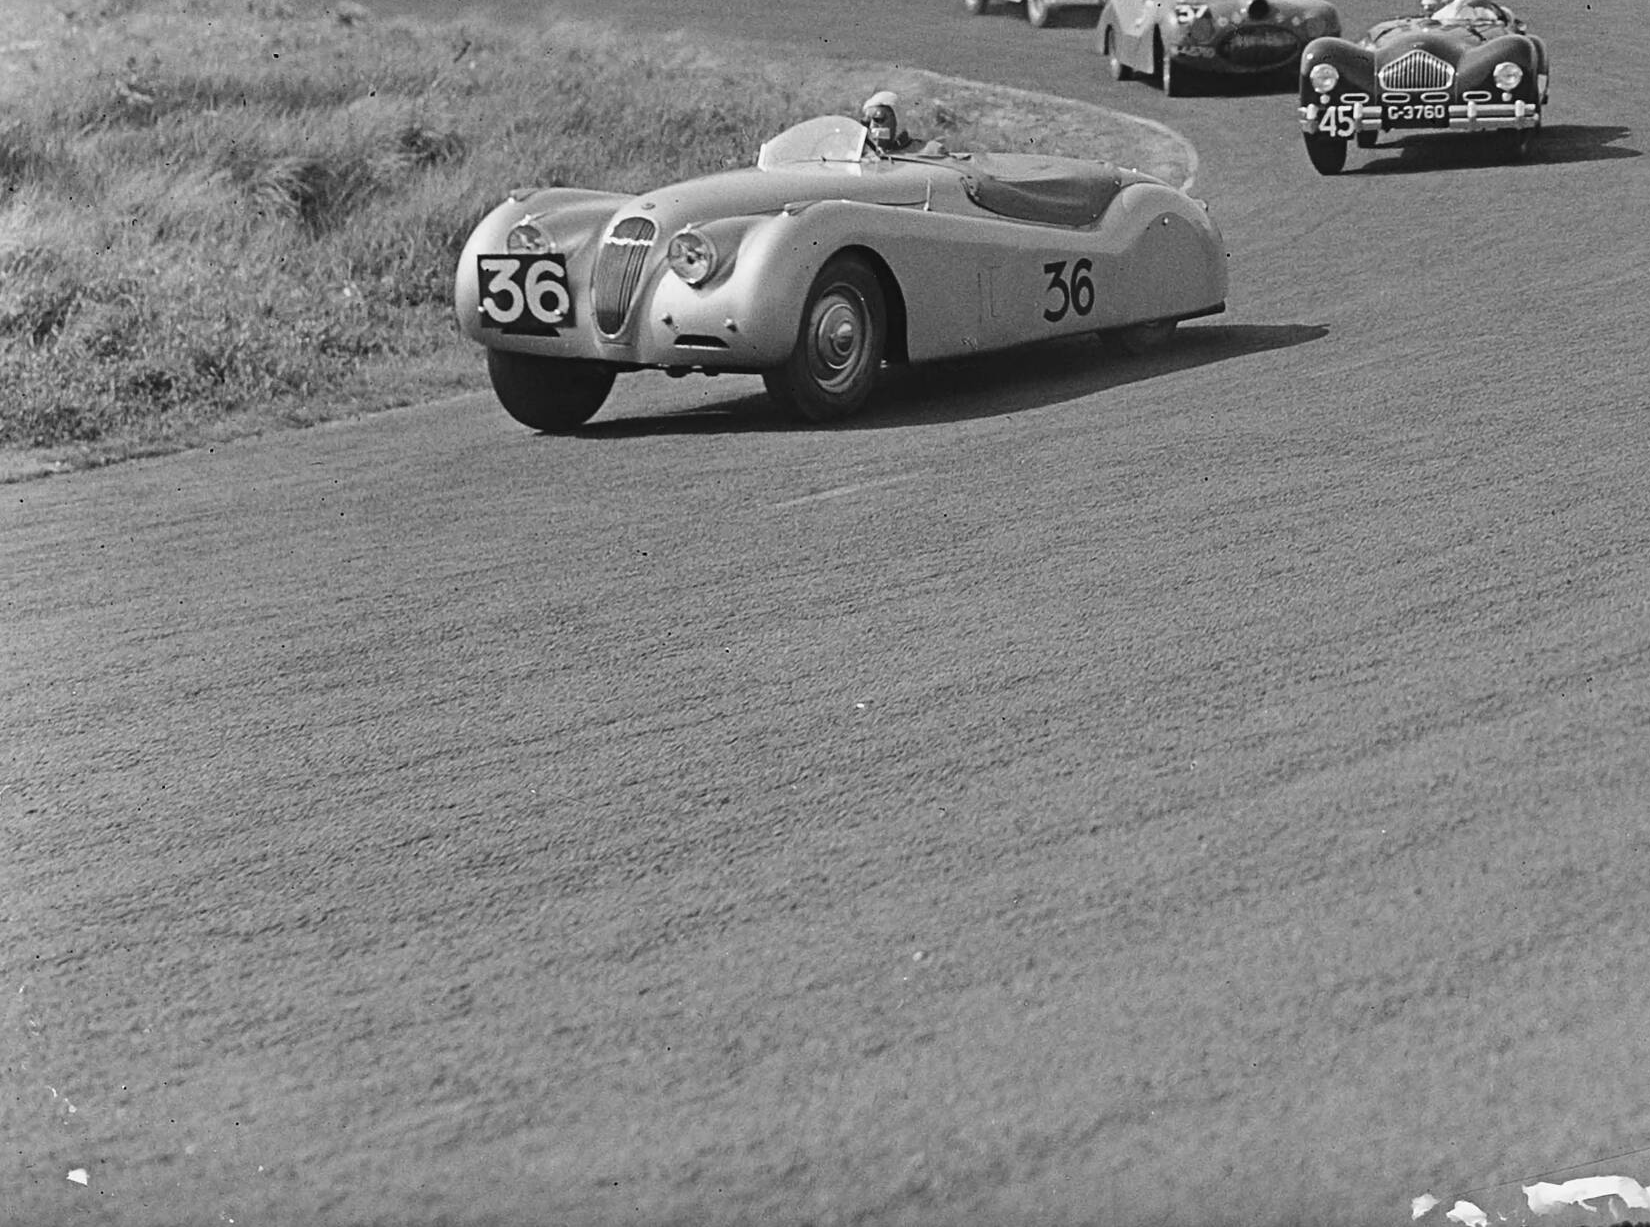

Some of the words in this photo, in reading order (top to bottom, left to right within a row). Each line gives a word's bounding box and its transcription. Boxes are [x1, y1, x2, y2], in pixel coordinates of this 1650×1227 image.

[1175, 4, 1208, 23] 37
[1319, 105, 1355, 137] 45
[480, 258, 570, 324] 36
[1043, 257, 1095, 323] 36
